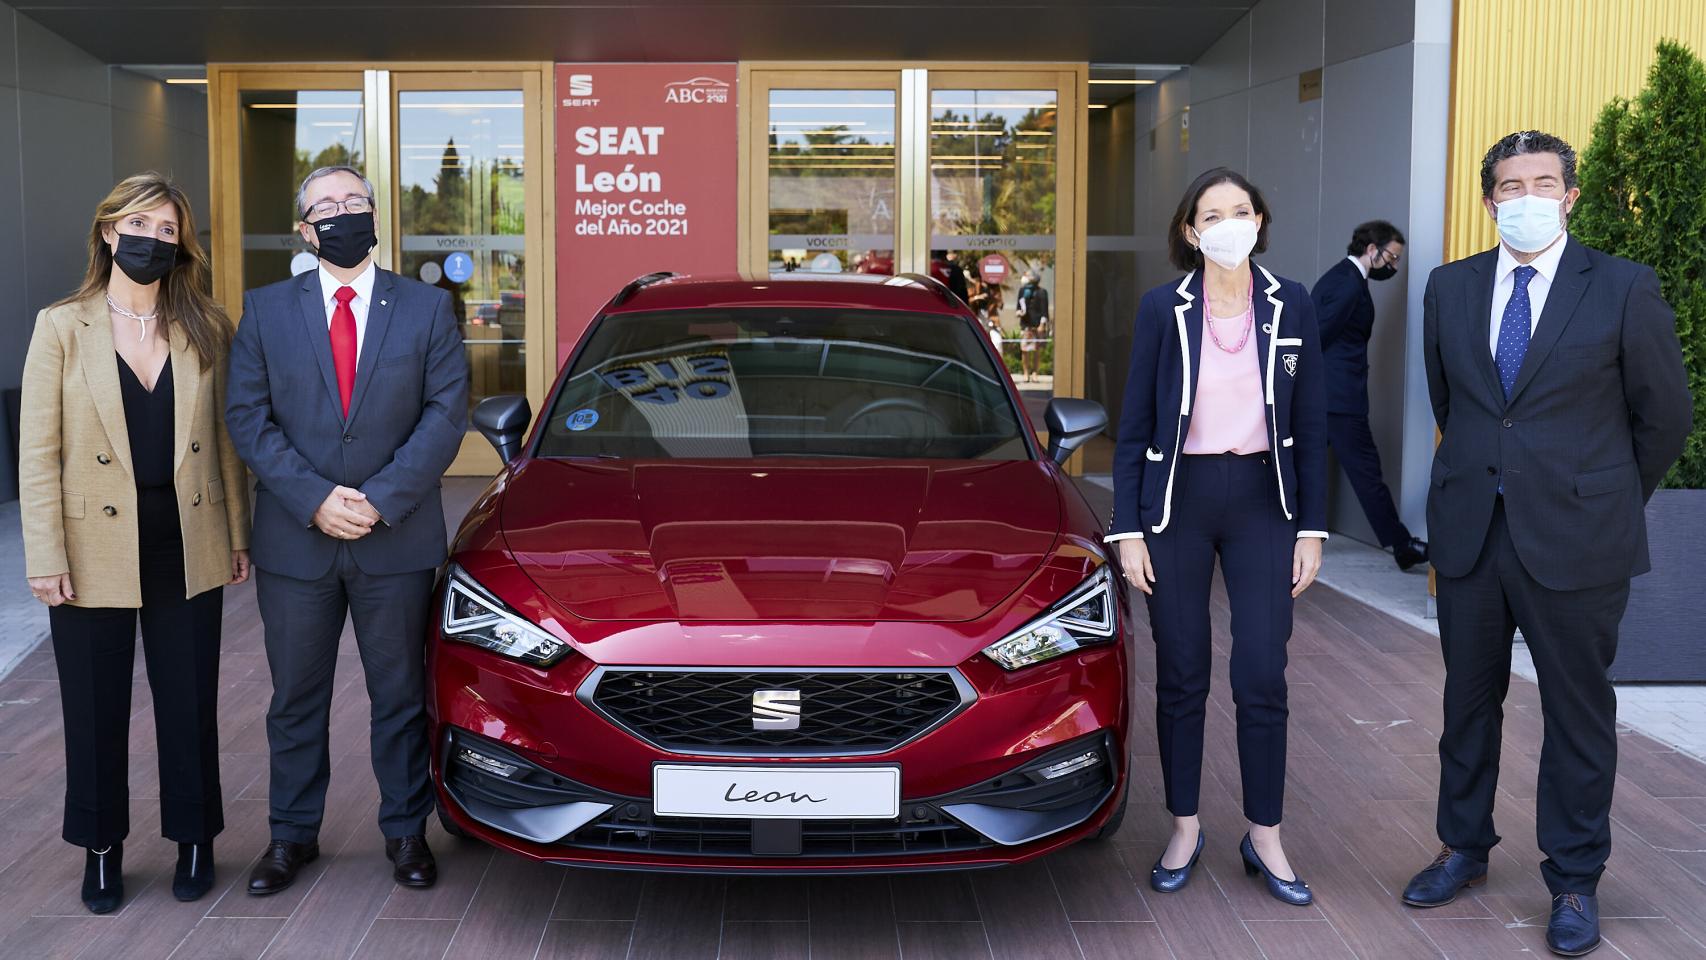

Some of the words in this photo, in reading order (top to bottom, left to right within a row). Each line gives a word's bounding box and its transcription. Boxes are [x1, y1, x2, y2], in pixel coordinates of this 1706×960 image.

[562, 99, 600, 107] SEAT
[665, 88, 705, 103] ABC
[575, 126, 665, 155] SEAT
[575, 164, 661, 193] León
[575, 199, 626, 219] Mejor
[629, 199, 687, 215] Coche
[575, 219, 604, 236] del
[607, 219, 642, 235] Año
[645, 219, 688, 235] 2021
[724, 782, 827, 803] Leon
